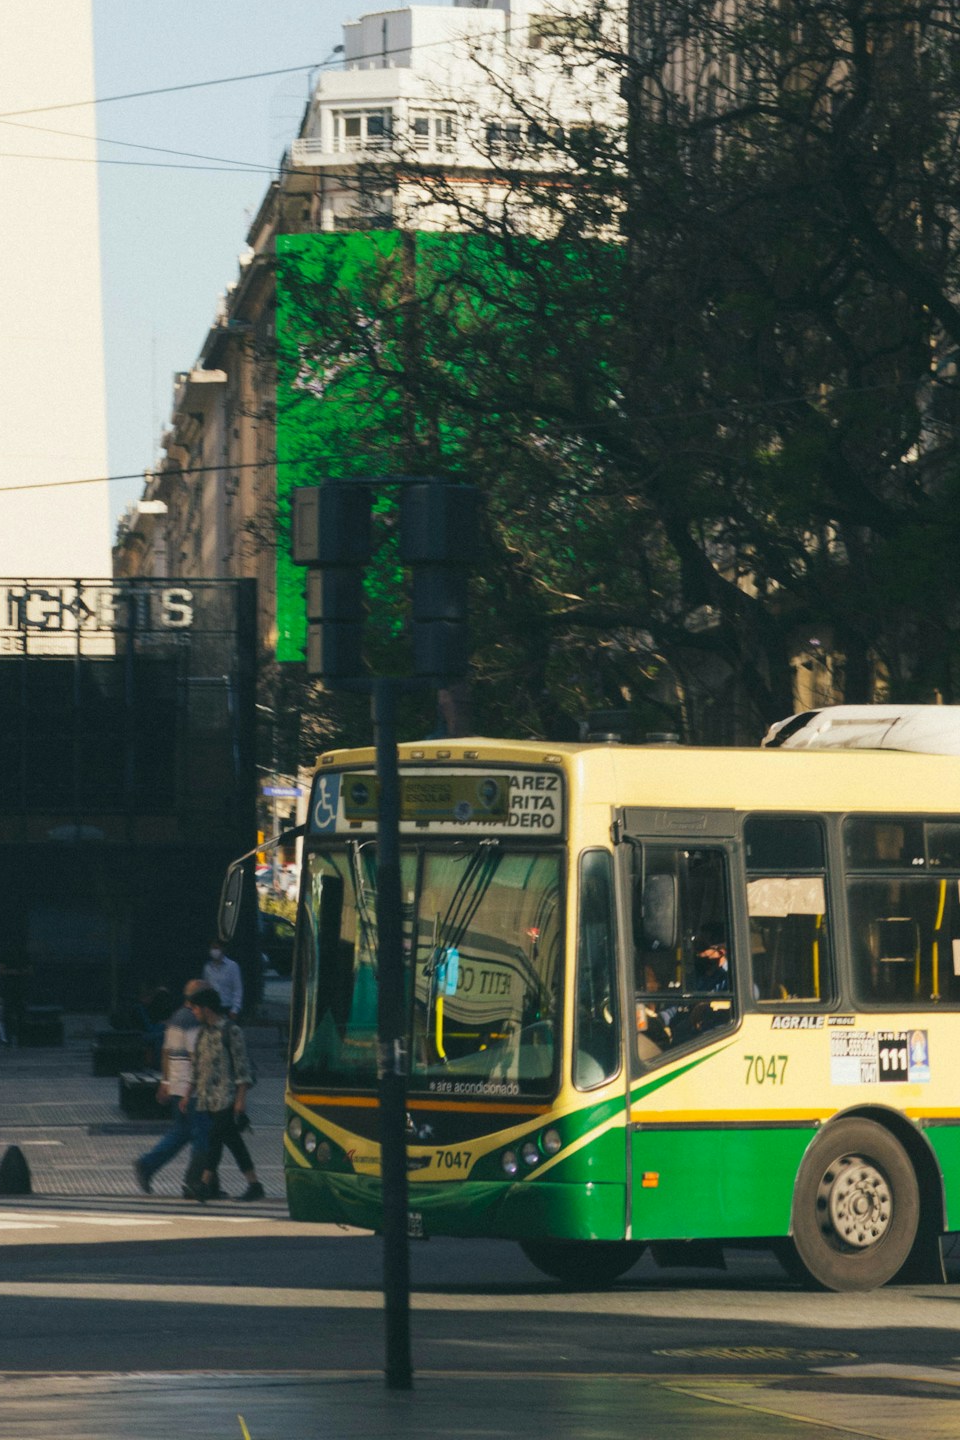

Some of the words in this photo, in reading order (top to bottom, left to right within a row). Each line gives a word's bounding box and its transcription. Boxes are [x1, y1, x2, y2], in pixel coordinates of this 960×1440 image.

[771, 1016, 824, 1029] AGRALE
[878, 1032, 907, 1041] LINEA
[880, 1048, 907, 1071] 111
[744, 1056, 788, 1085] 7047
[454, 1081, 519, 1095] acondicionado
[436, 1151, 471, 1168] 7047
